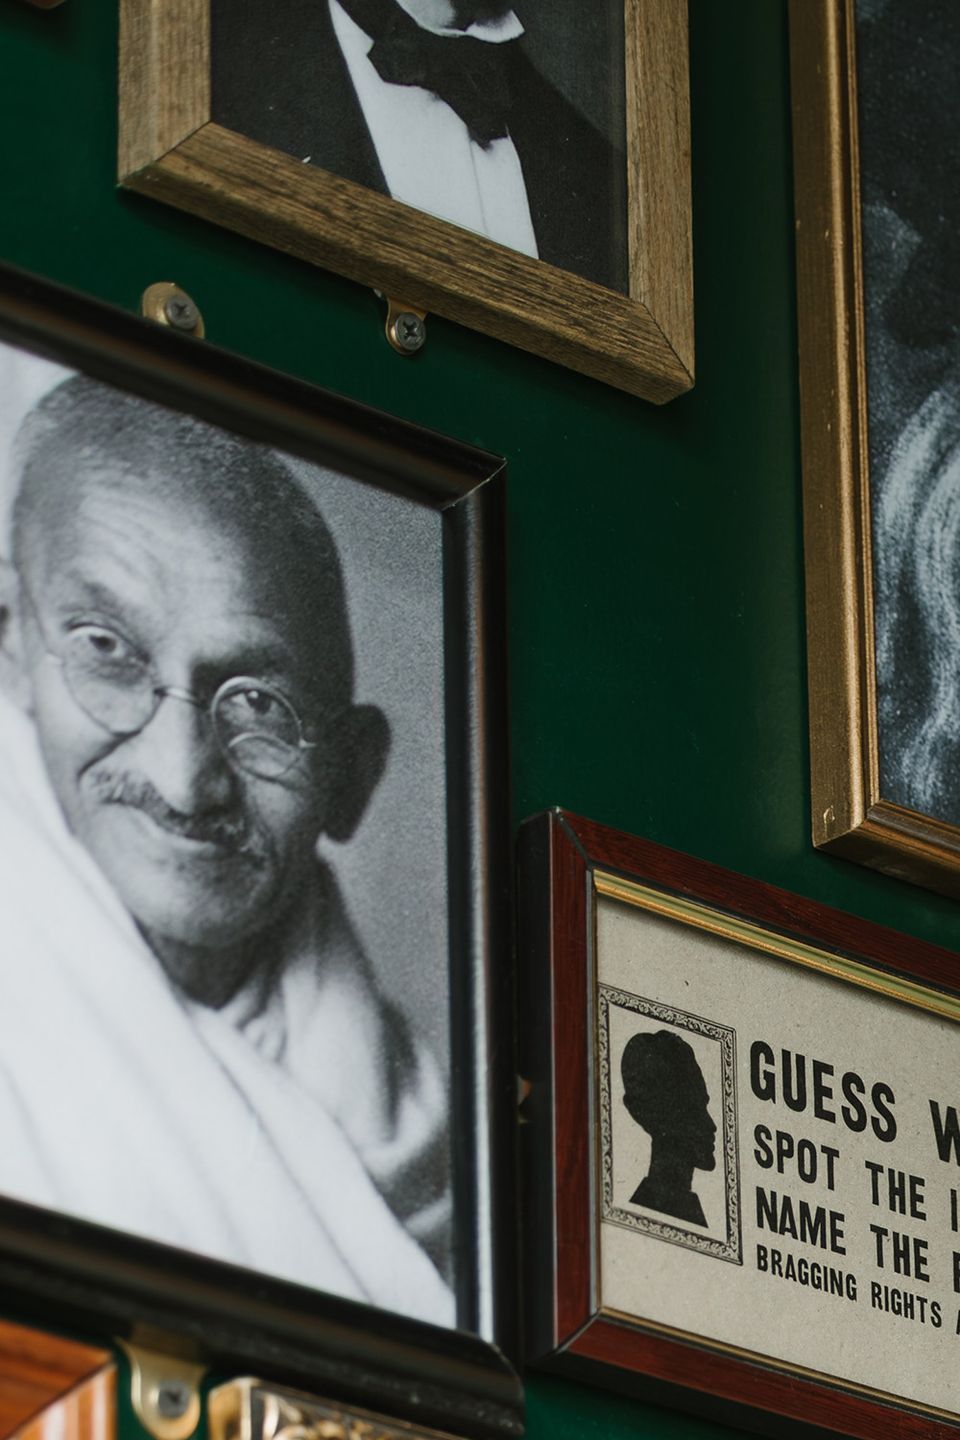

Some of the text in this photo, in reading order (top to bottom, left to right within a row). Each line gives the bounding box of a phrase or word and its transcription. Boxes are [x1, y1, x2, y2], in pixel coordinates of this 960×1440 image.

[749, 1039, 898, 1143] GUESS
[753, 1123, 840, 1192] SPOT
[864, 1159, 927, 1222] THE
[755, 1185, 847, 1256] NAME
[869, 1223, 930, 1284] THE
[756, 1243, 858, 1302] BRAGGING
[870, 1280, 943, 1329] RIGHTS
